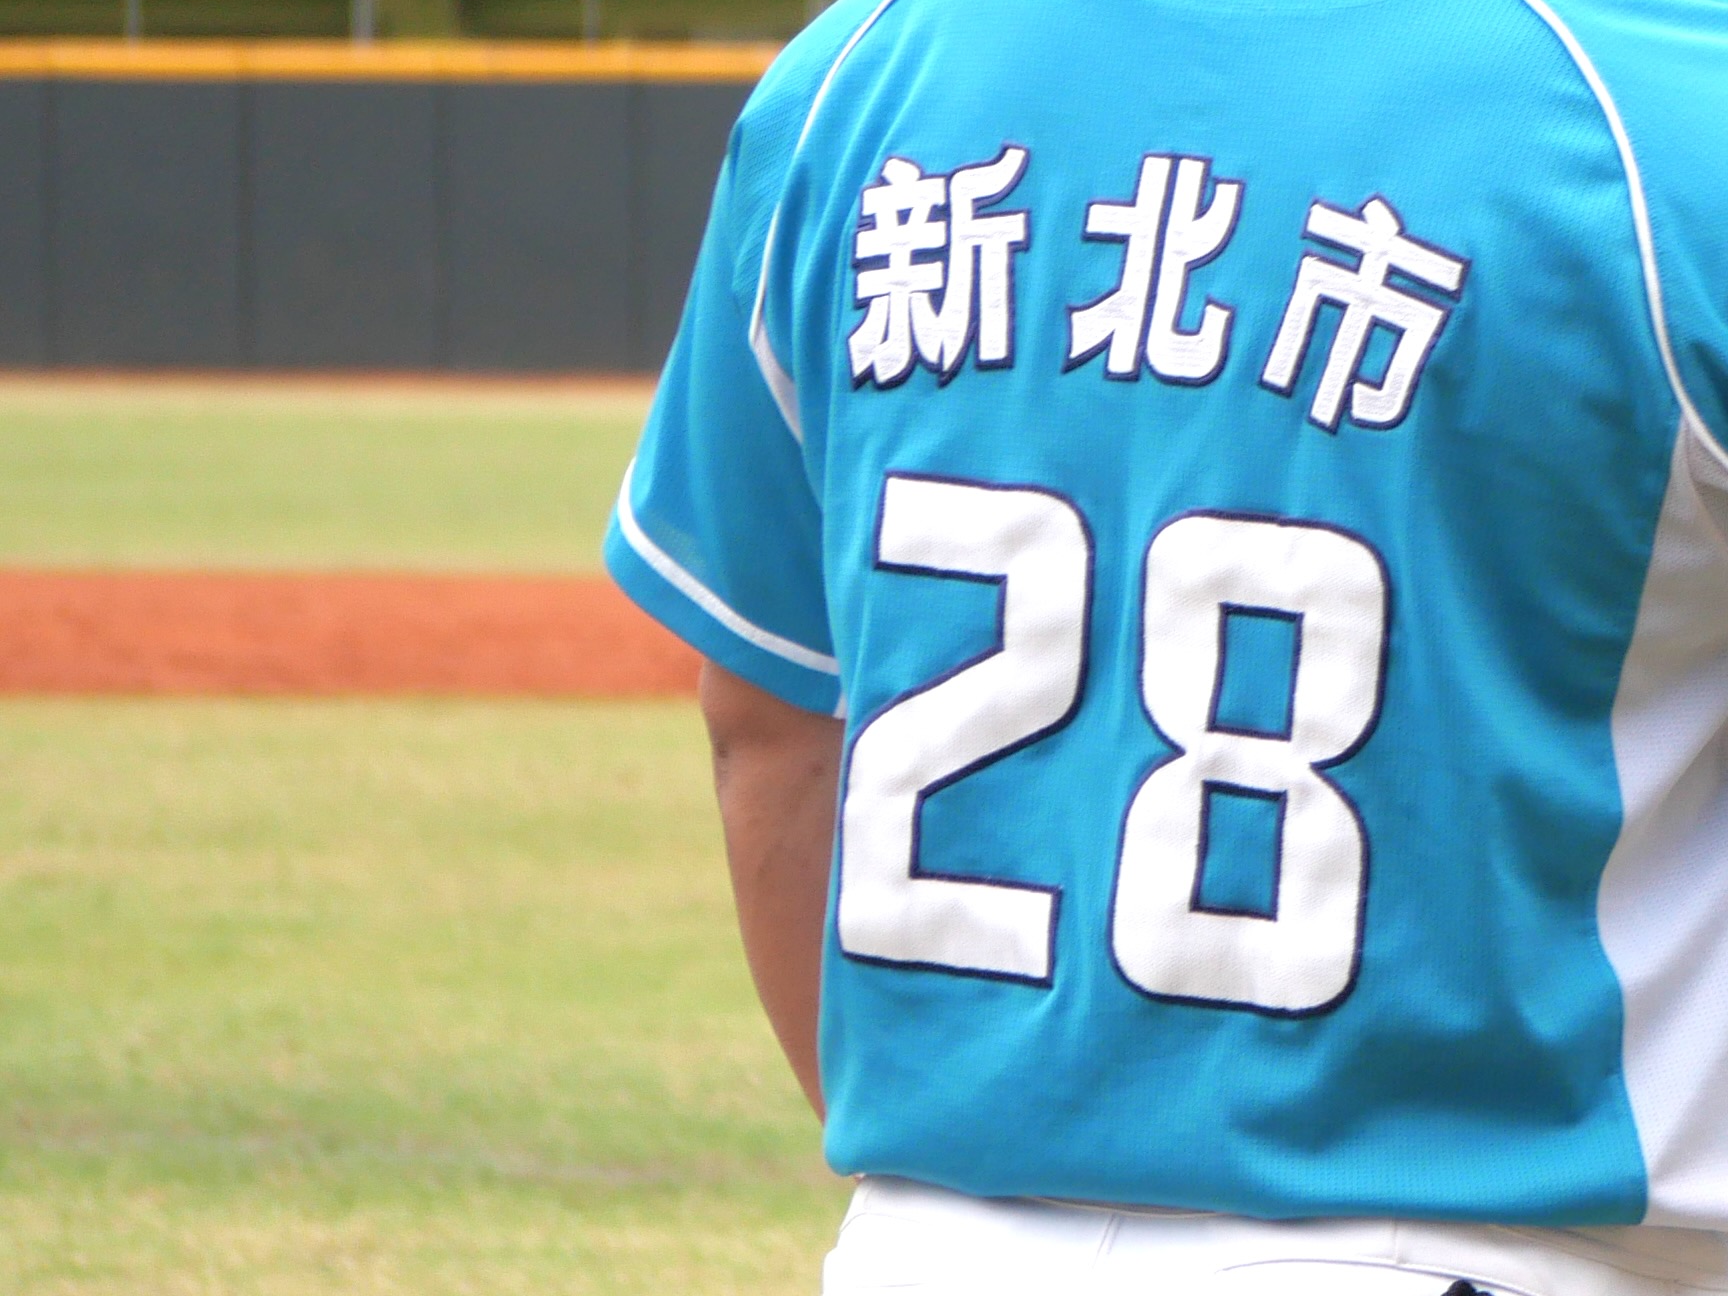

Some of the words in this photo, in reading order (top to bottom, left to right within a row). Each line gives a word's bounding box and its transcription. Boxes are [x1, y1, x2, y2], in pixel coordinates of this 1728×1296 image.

[849, 144, 1471, 434] 新北市
[838, 471, 1391, 1018] 28
